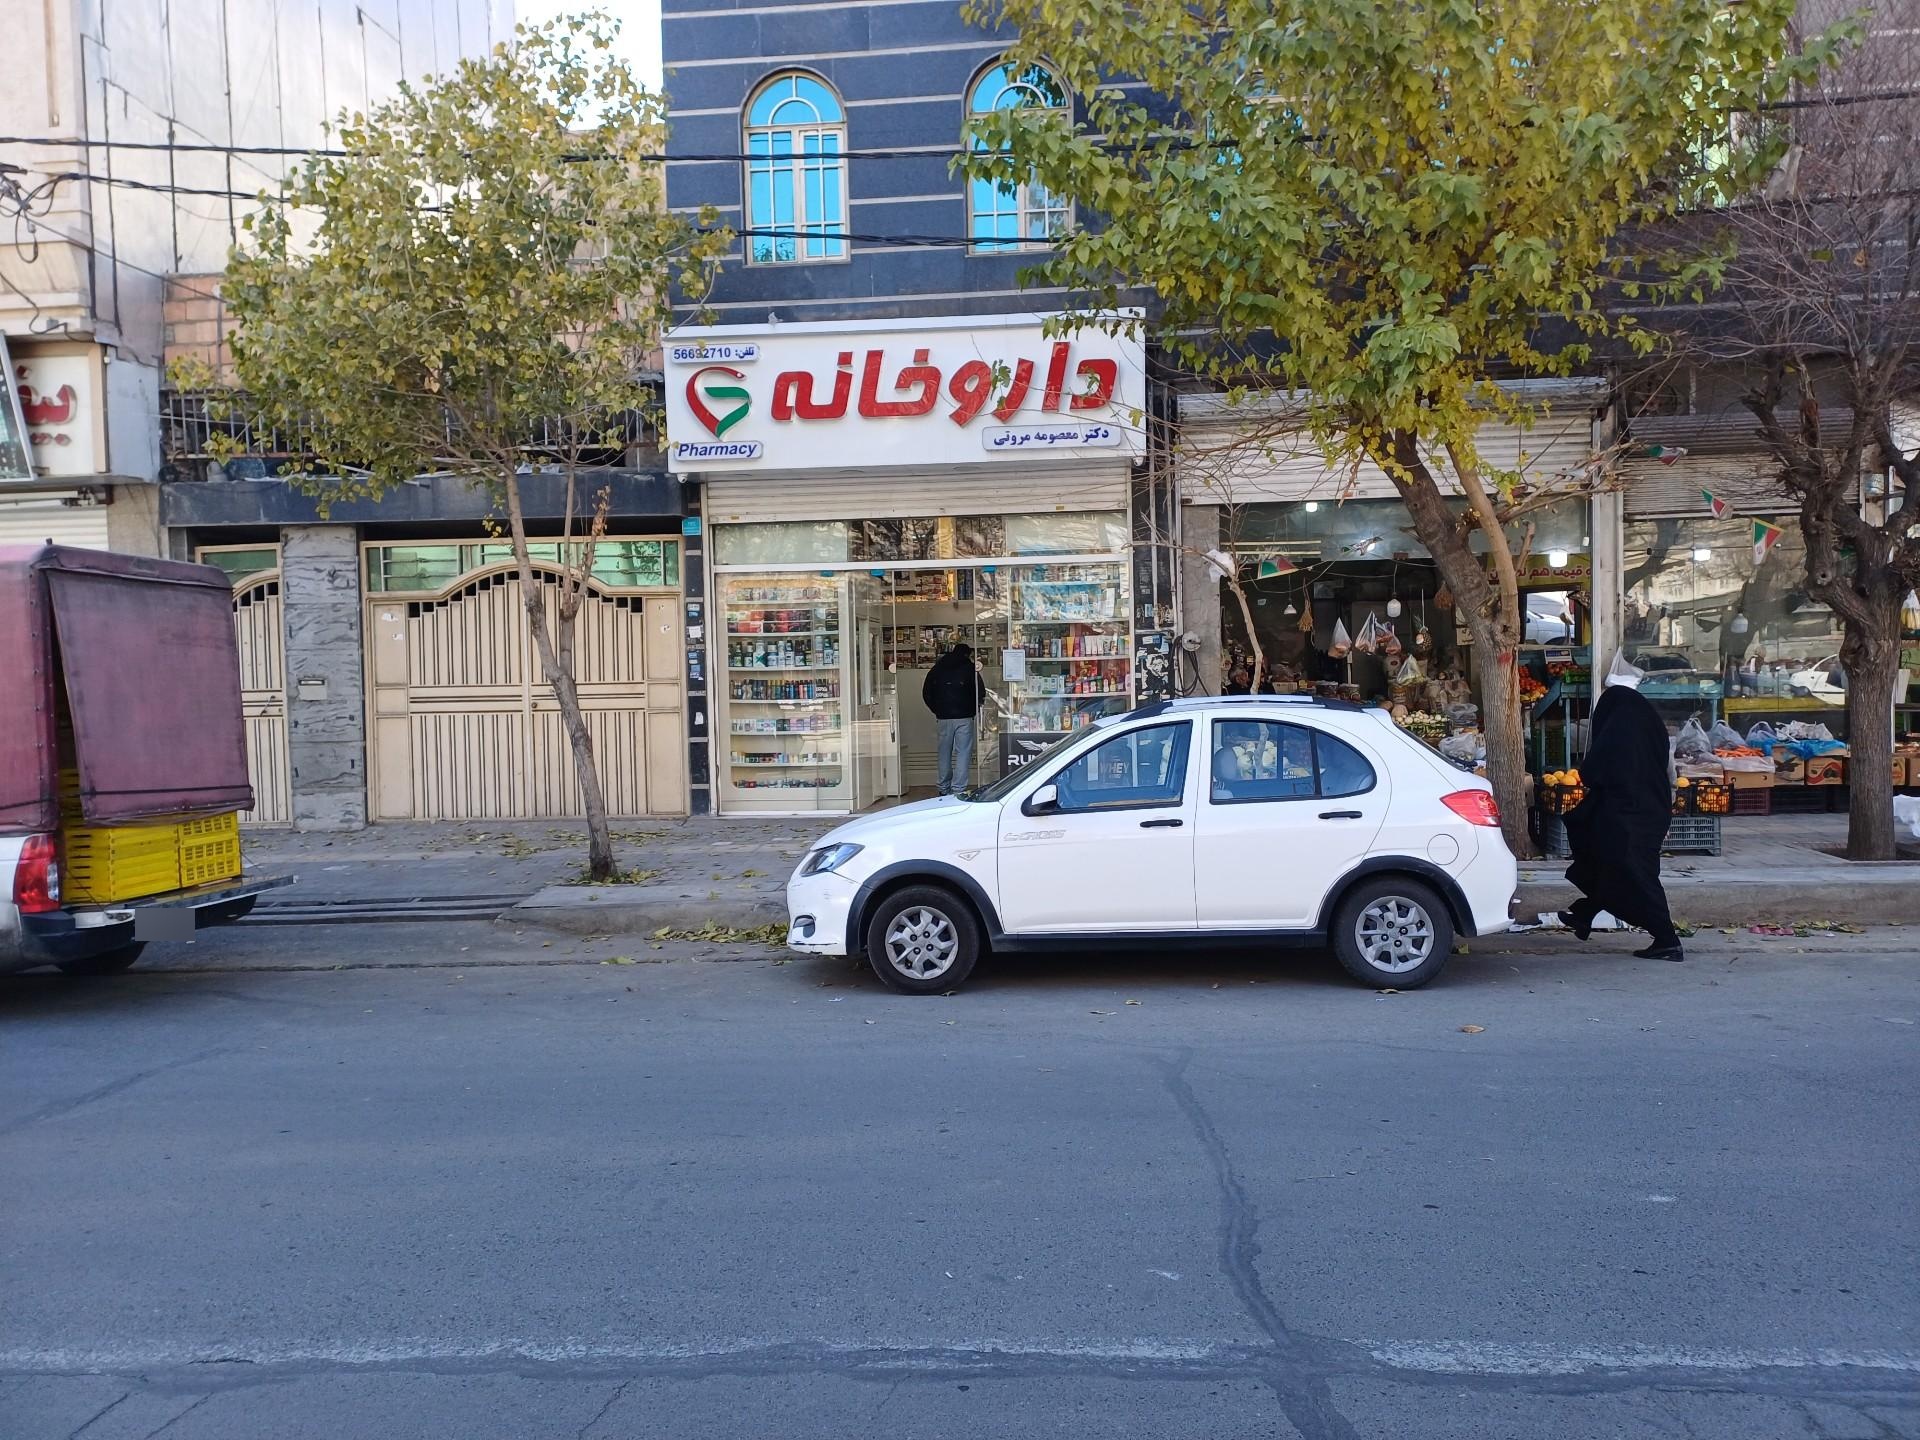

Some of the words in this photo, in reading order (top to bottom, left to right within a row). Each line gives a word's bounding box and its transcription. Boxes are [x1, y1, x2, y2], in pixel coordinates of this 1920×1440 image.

[771, 341, 1120, 428] داروخانه
[1034, 430, 1079, 444] معصومه
[1082, 427, 1110, 443] دکتر
[678, 443, 758, 458] Pharmacy
[1007, 754, 1037, 766] RU
[1100, 761, 1130, 774] WHEY
